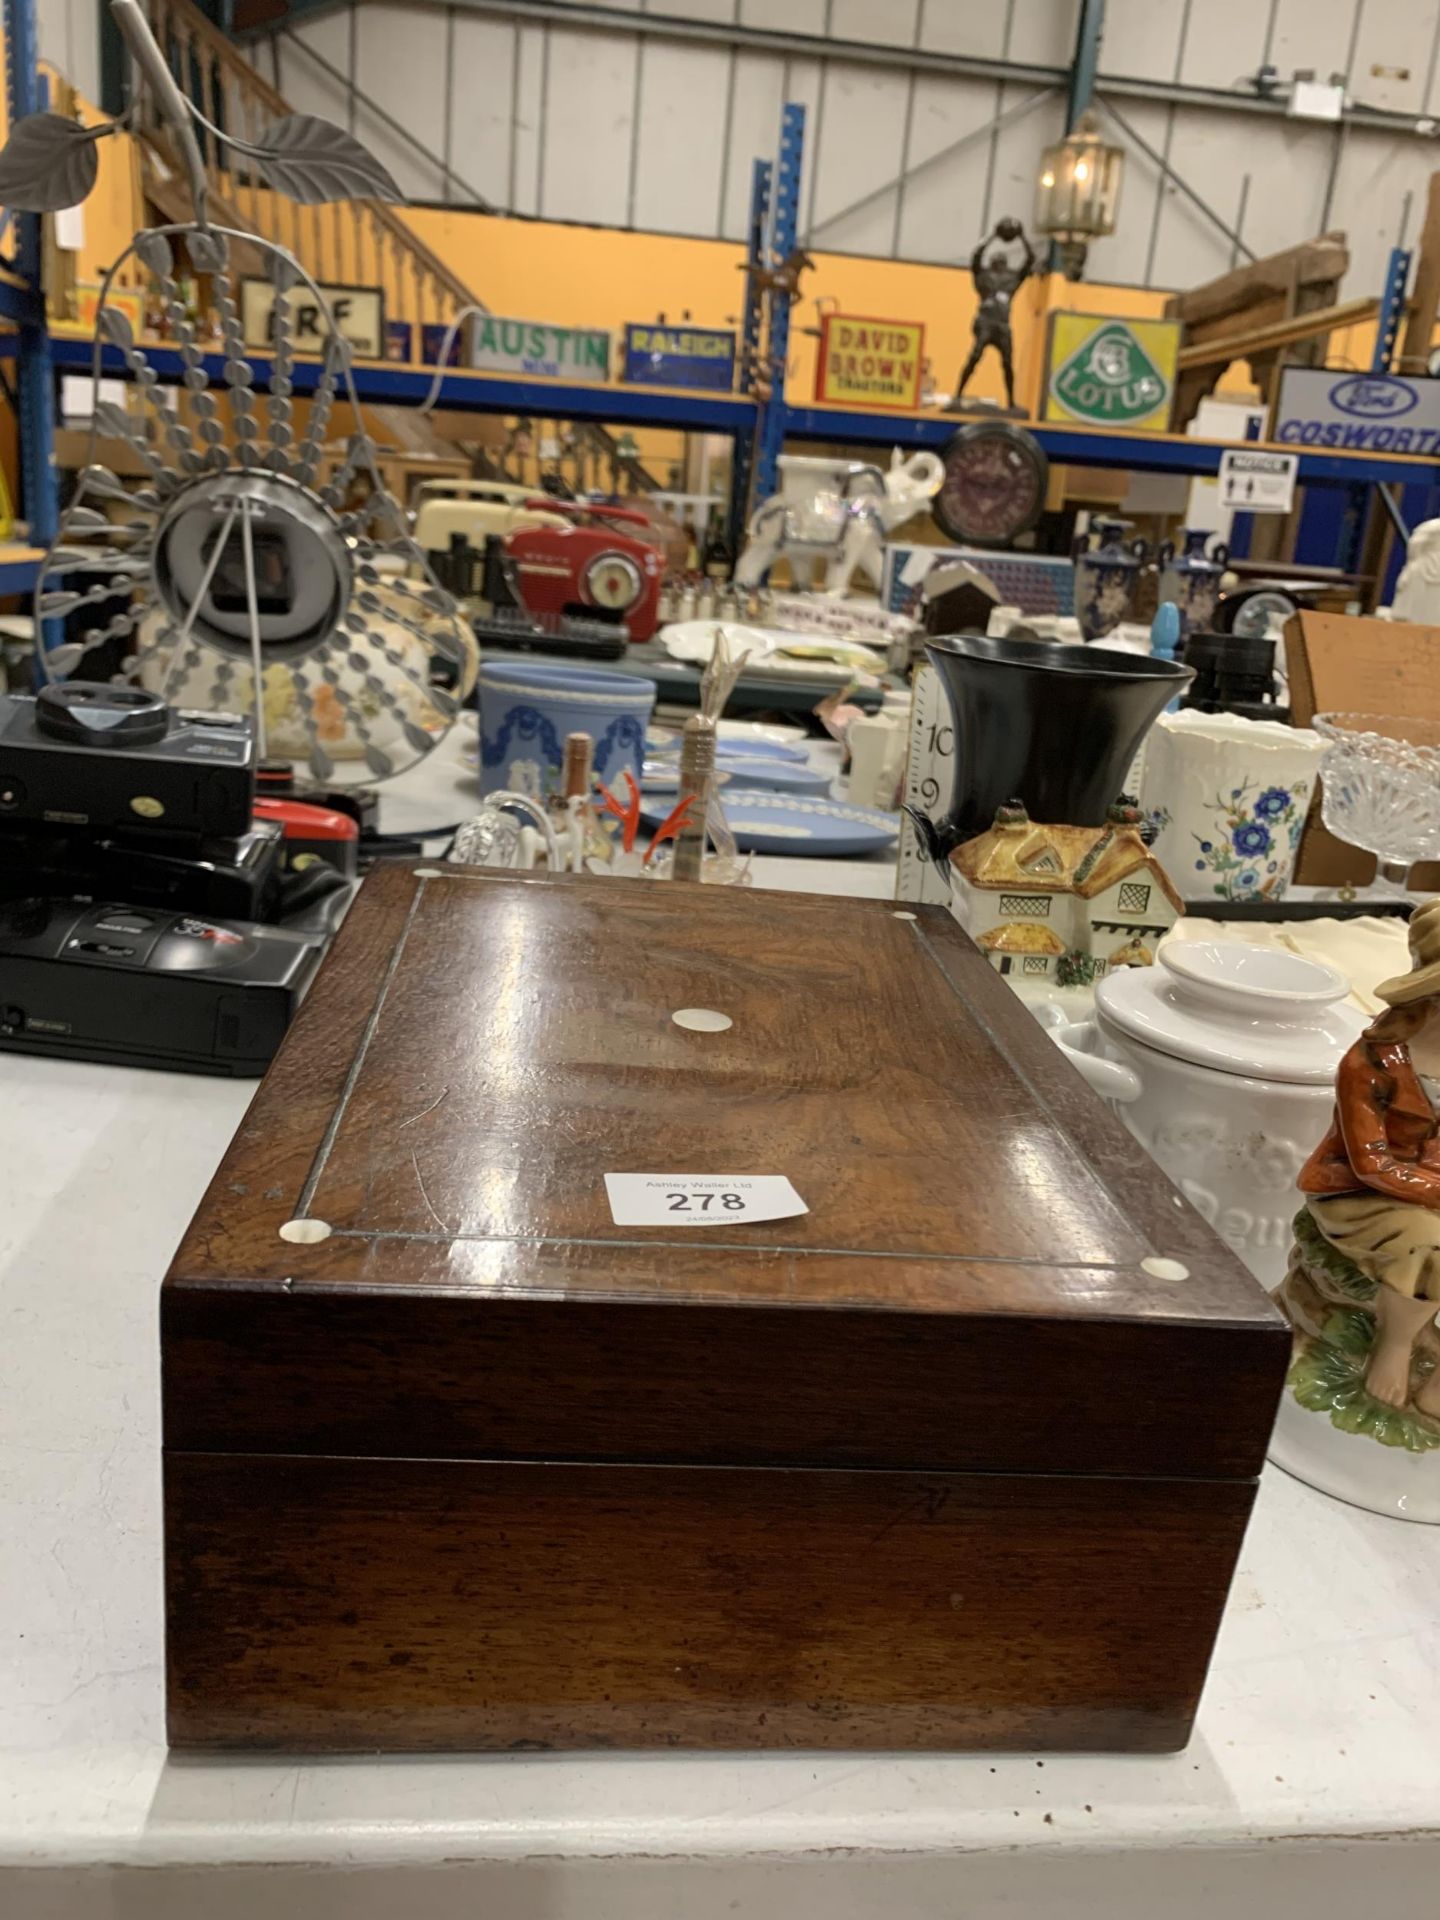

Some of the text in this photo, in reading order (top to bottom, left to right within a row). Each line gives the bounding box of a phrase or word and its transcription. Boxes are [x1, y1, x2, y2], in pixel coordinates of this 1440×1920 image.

[267, 299, 351, 342] RF
[480, 318, 606, 369] AUSTIN
[631, 330, 731, 358] RALEIGH
[839, 326, 910, 355] DAVID
[830, 352, 914, 383] BROWN
[1060, 368, 1162, 411] LOTUS
[1346, 382, 1399, 408] Ford
[926, 724, 955, 757] 10
[920, 777, 940, 809] 9
[665, 1193, 746, 1211] 278
